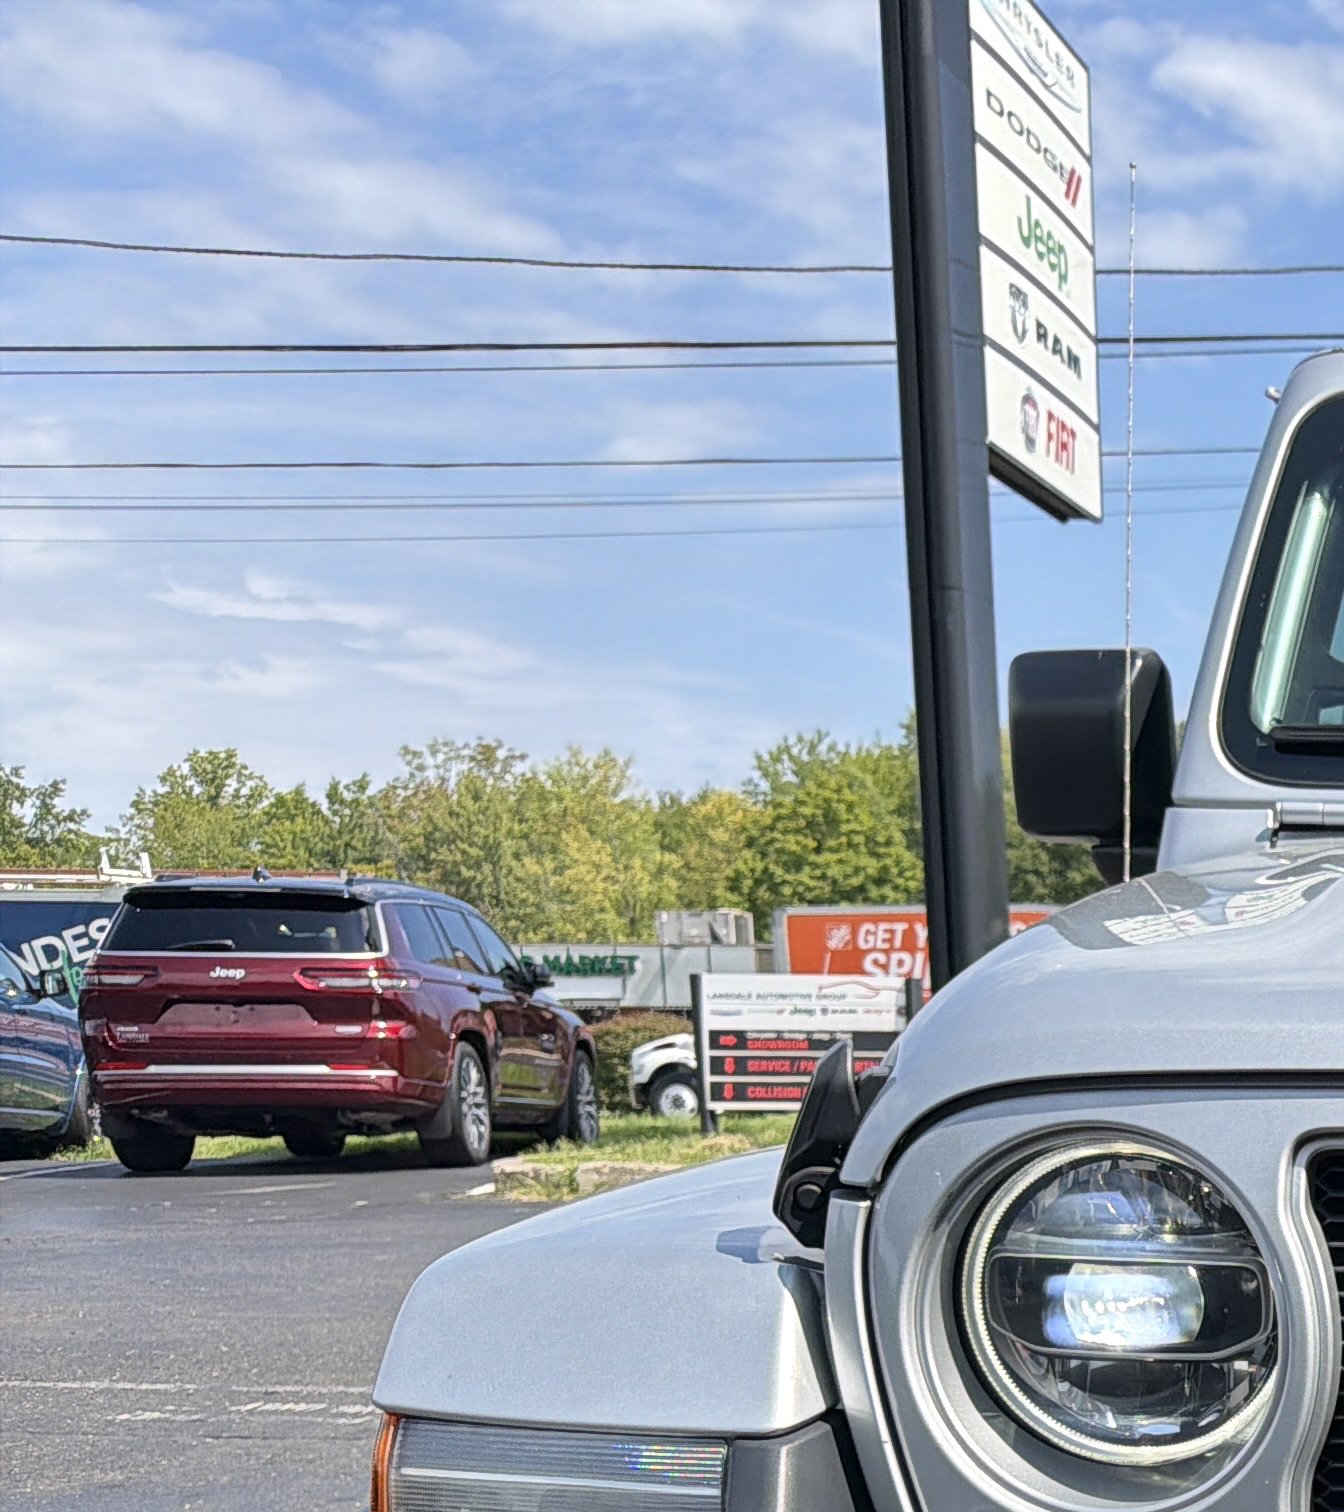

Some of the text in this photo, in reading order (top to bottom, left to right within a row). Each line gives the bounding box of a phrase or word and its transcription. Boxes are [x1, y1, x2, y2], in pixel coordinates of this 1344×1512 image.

[1000, 0, 1076, 89] RYSLER
[986, 87, 1067, 184] DODGE
[1017, 194, 1068, 291] Jeep
[1035, 316, 1081, 380] RAM
[1046, 408, 1077, 475] FIAT
[857, 921, 909, 950] GET
[209, 966, 246, 980] Jeep
[542, 954, 640, 975] MARKET
[746, 1039, 809, 1050] SHOWROOM
[746, 1059, 791, 1073] SERVICE
[746, 1086, 802, 1099] COLLISION
